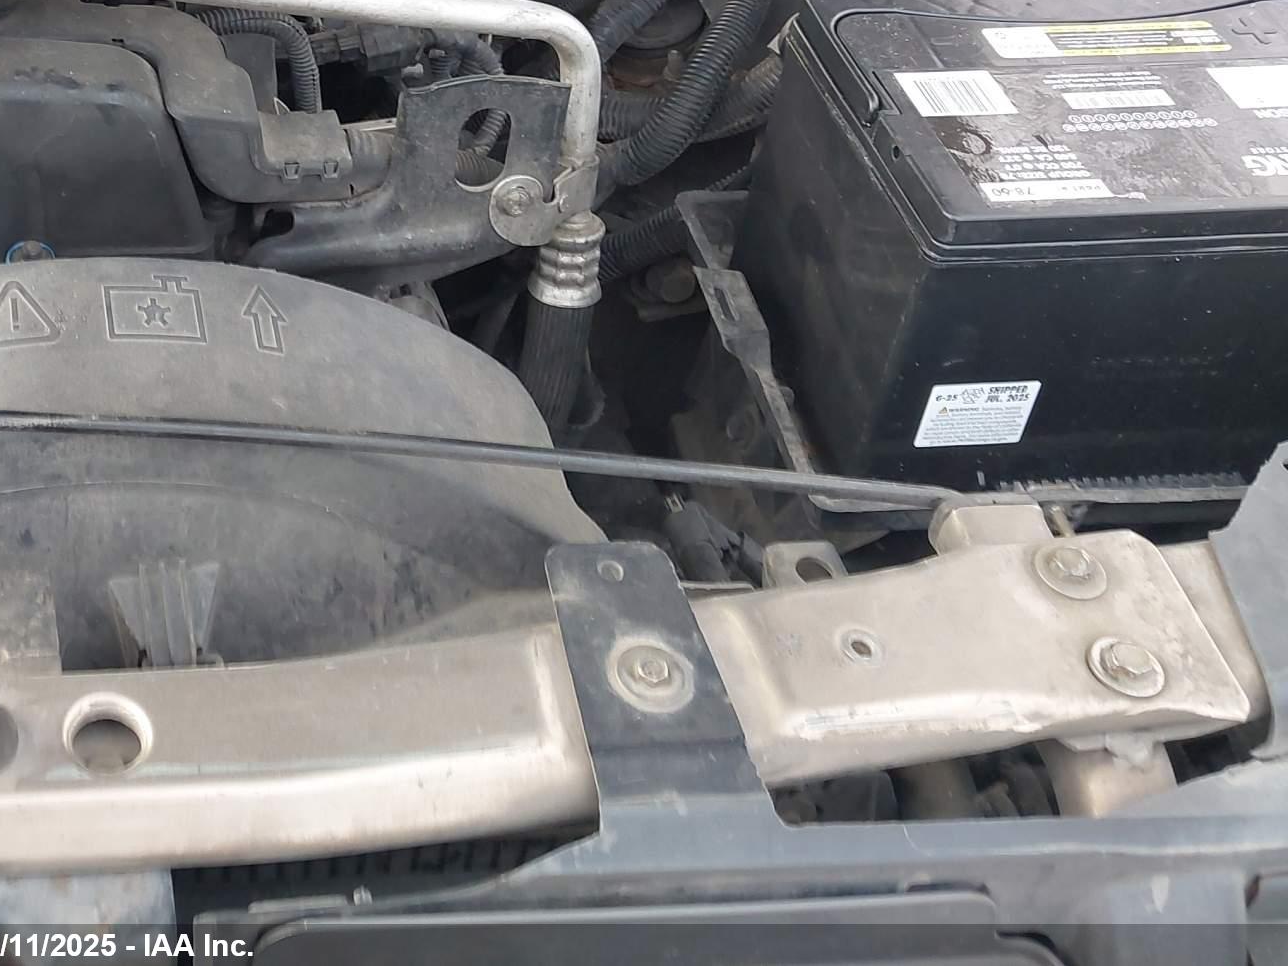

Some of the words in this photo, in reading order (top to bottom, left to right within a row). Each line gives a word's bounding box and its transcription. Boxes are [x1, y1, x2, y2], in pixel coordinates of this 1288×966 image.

[1047, 169, 1092, 179] GROUP
[988, 385, 1029, 395] SHIPPED
[1006, 394, 1031, 403] 2025
